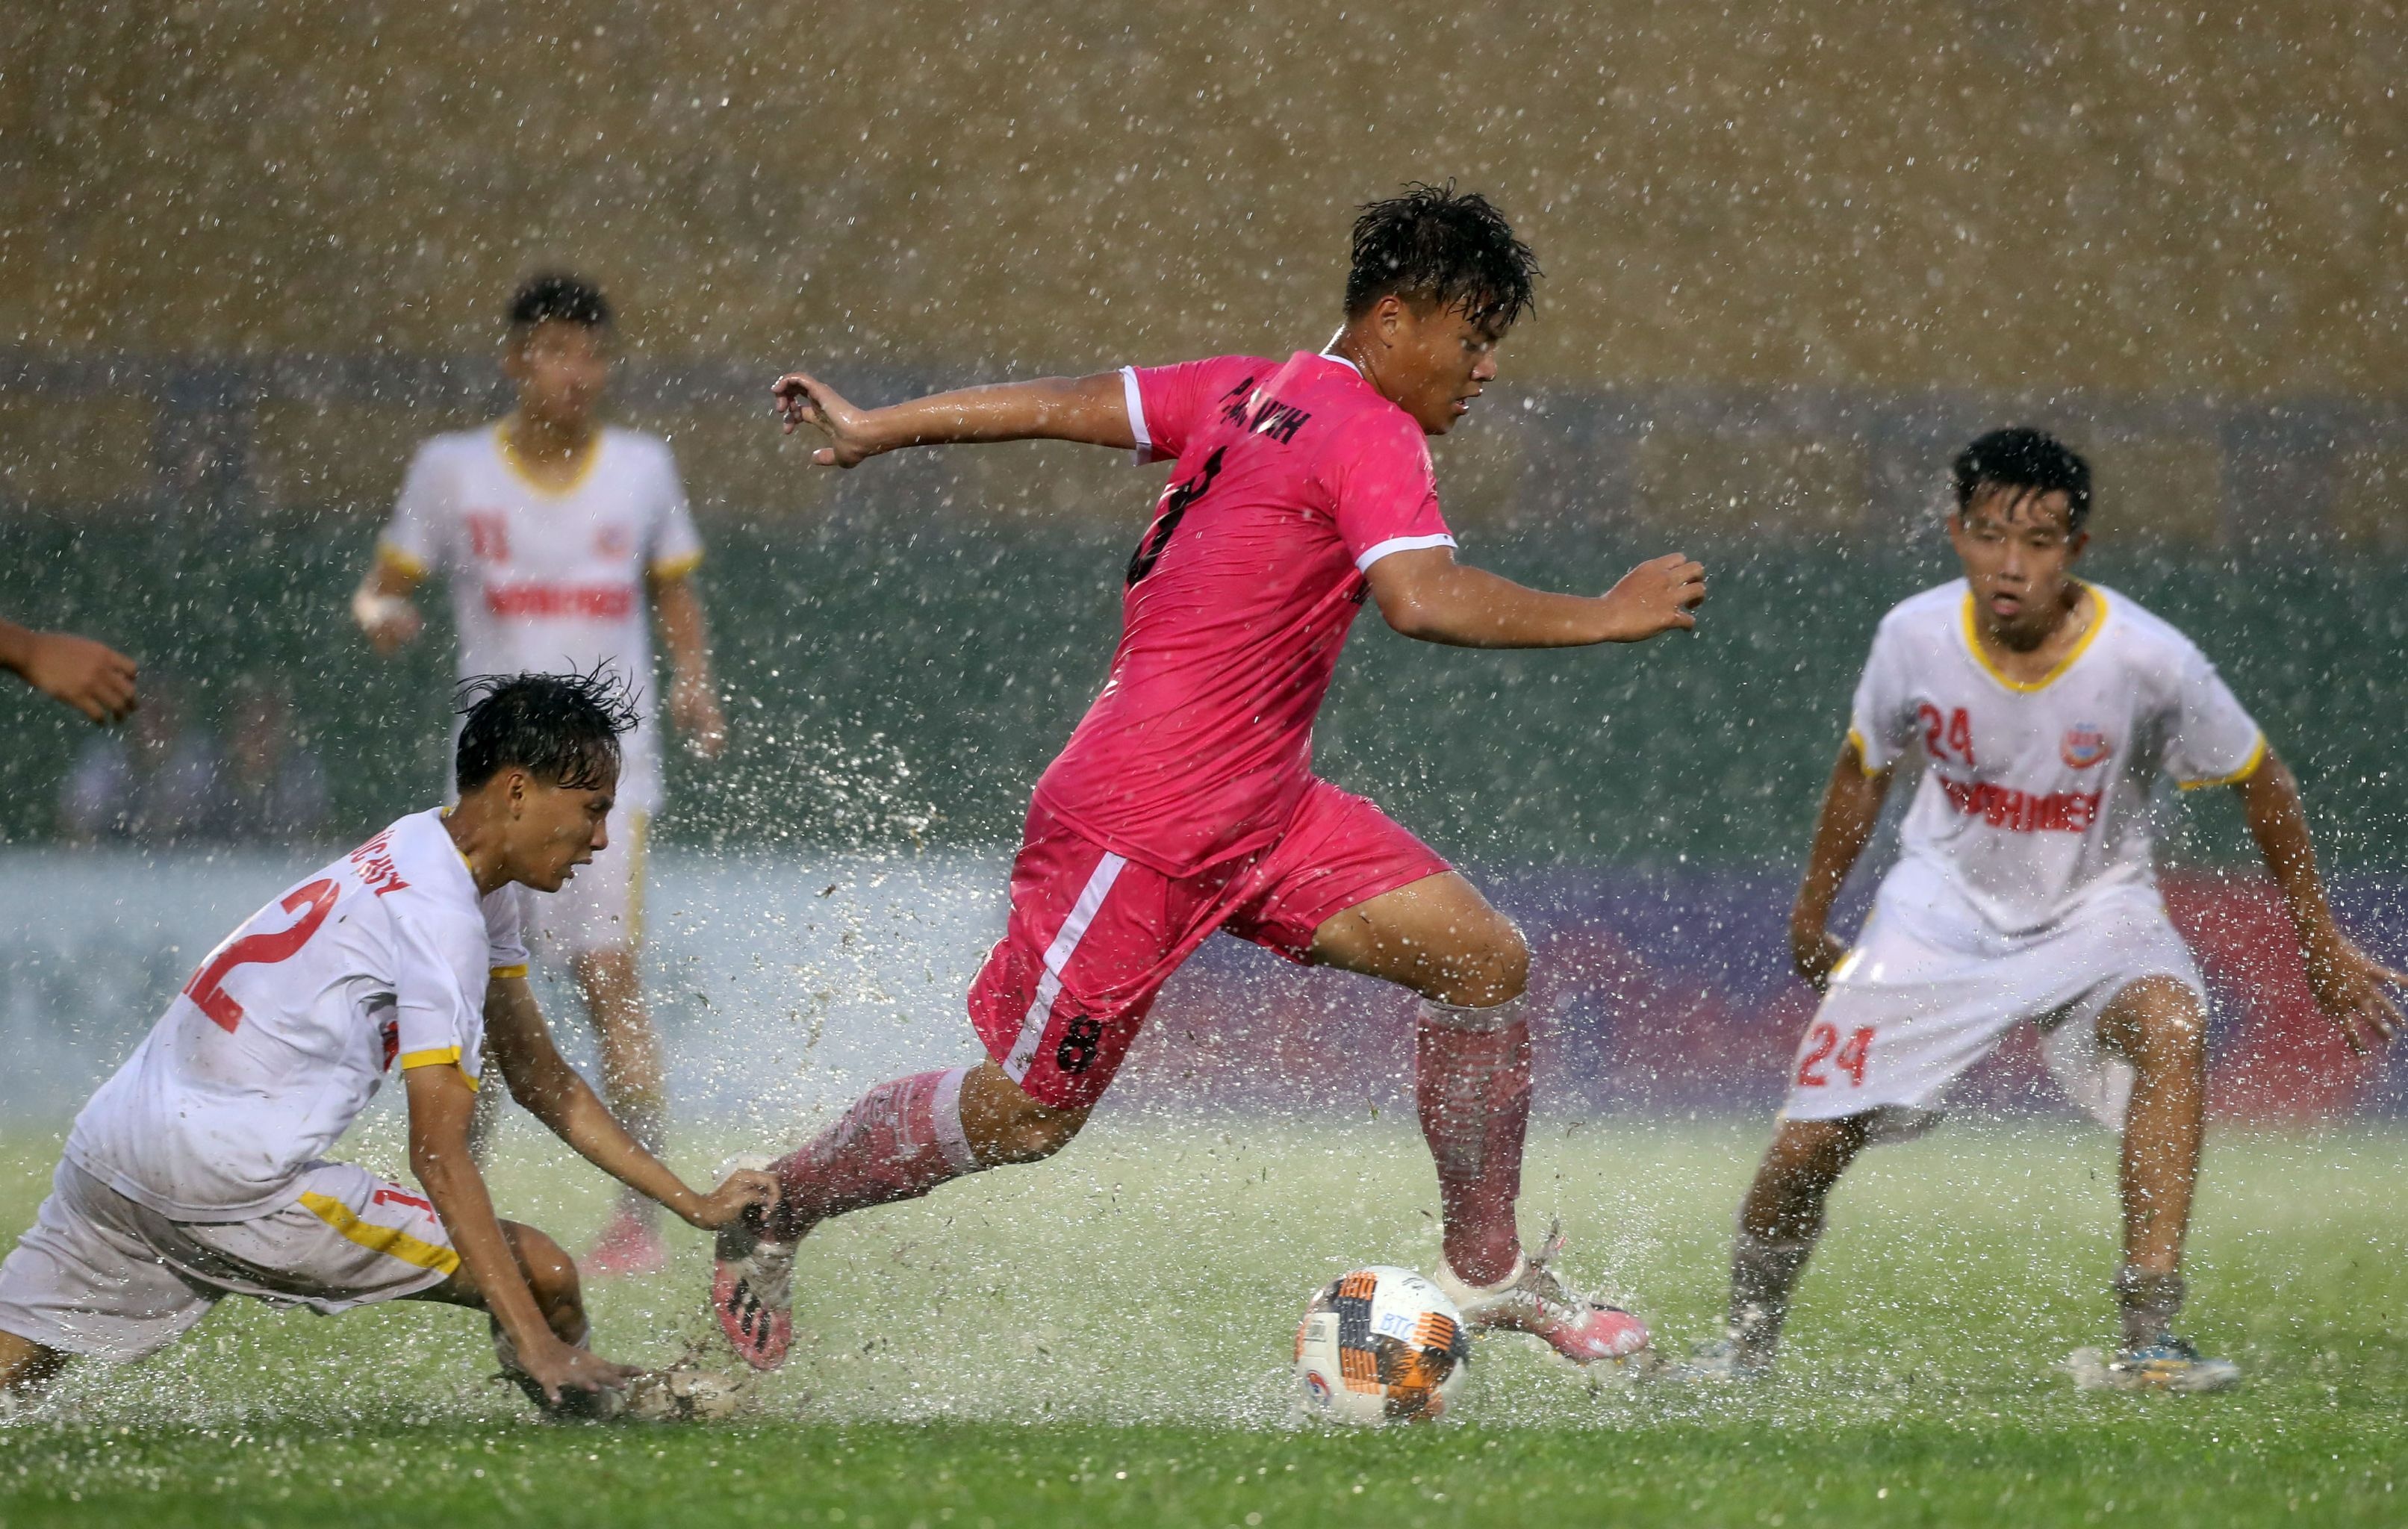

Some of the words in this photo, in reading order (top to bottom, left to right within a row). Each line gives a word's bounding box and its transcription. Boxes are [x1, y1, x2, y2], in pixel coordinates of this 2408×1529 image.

[1917, 703, 1975, 765] 24
[183, 878, 340, 1034] 2
[1057, 1014, 1102, 1074] 8
[1798, 1023, 1875, 1087] 24
[1380, 1312, 1416, 1341] BTC
